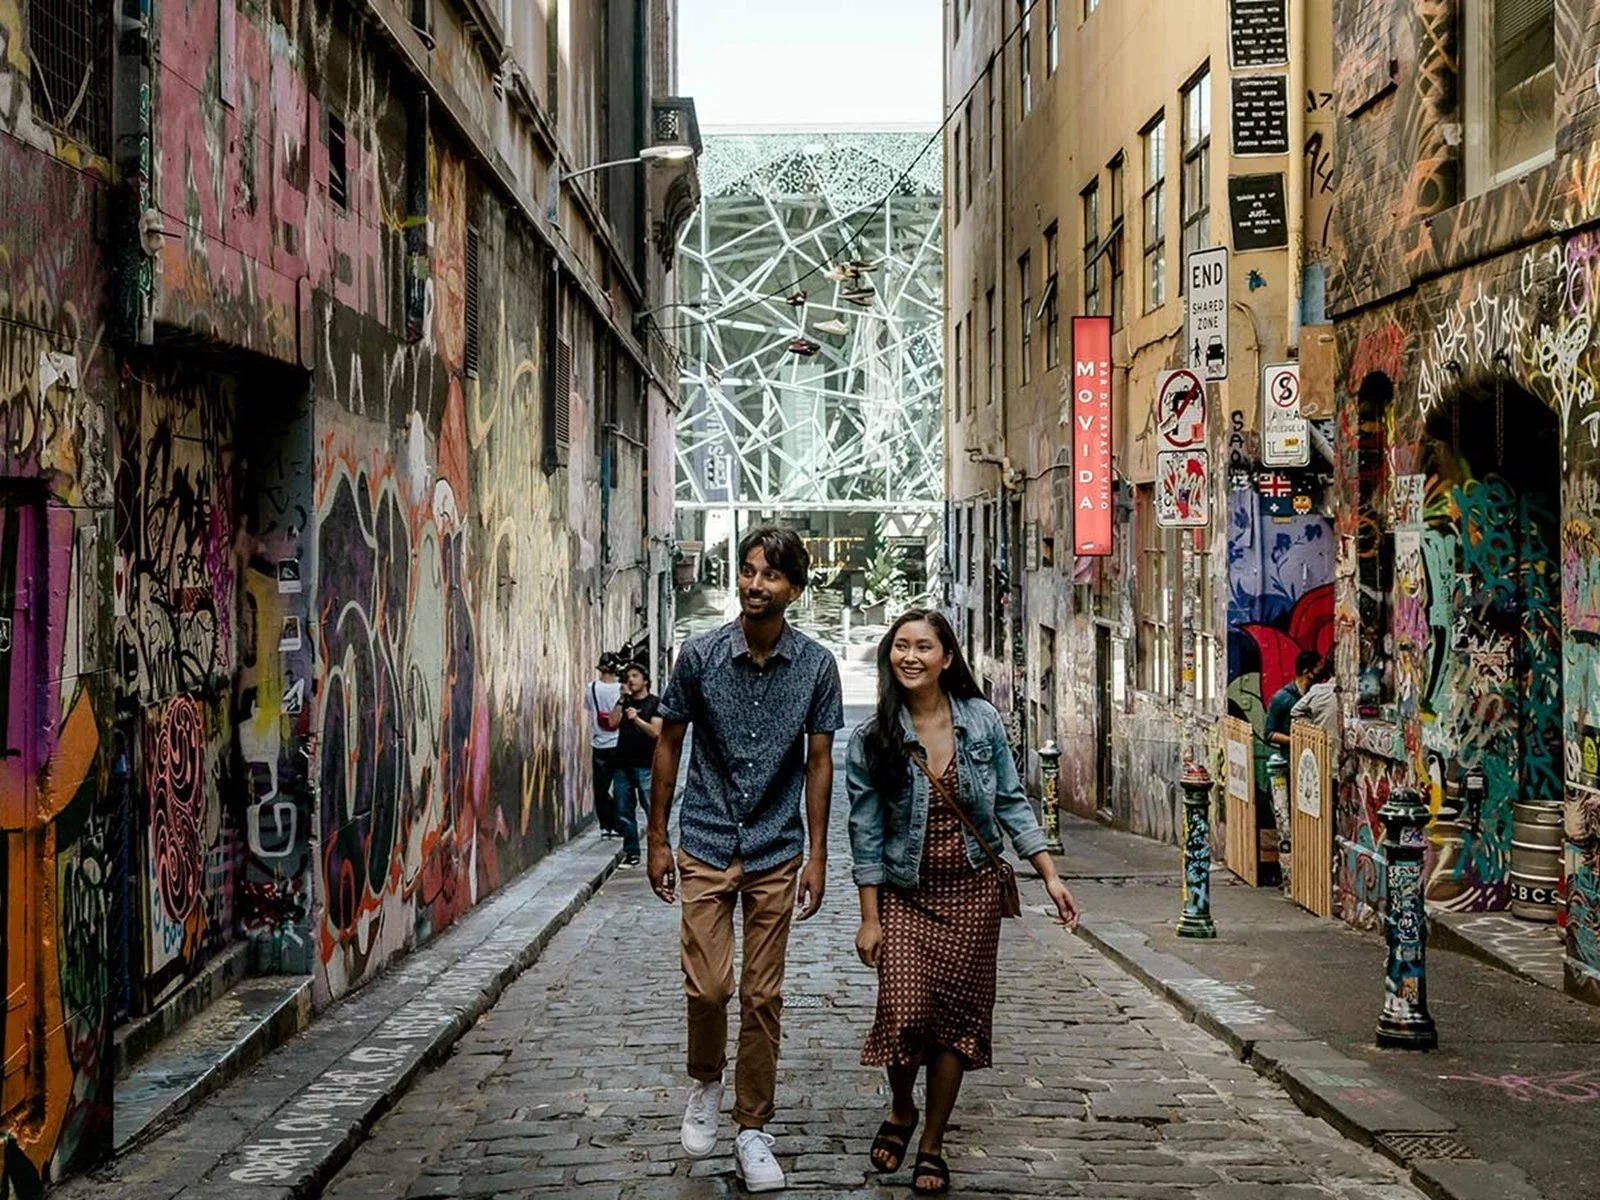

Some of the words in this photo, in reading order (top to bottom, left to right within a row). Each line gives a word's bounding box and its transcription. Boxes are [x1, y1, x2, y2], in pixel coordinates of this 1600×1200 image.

[1193, 262, 1223, 289] END
[1192, 299, 1225, 315] SHARED
[1198, 316, 1218, 331] ZONE
[1076, 361, 1095, 509] MOVIDA
